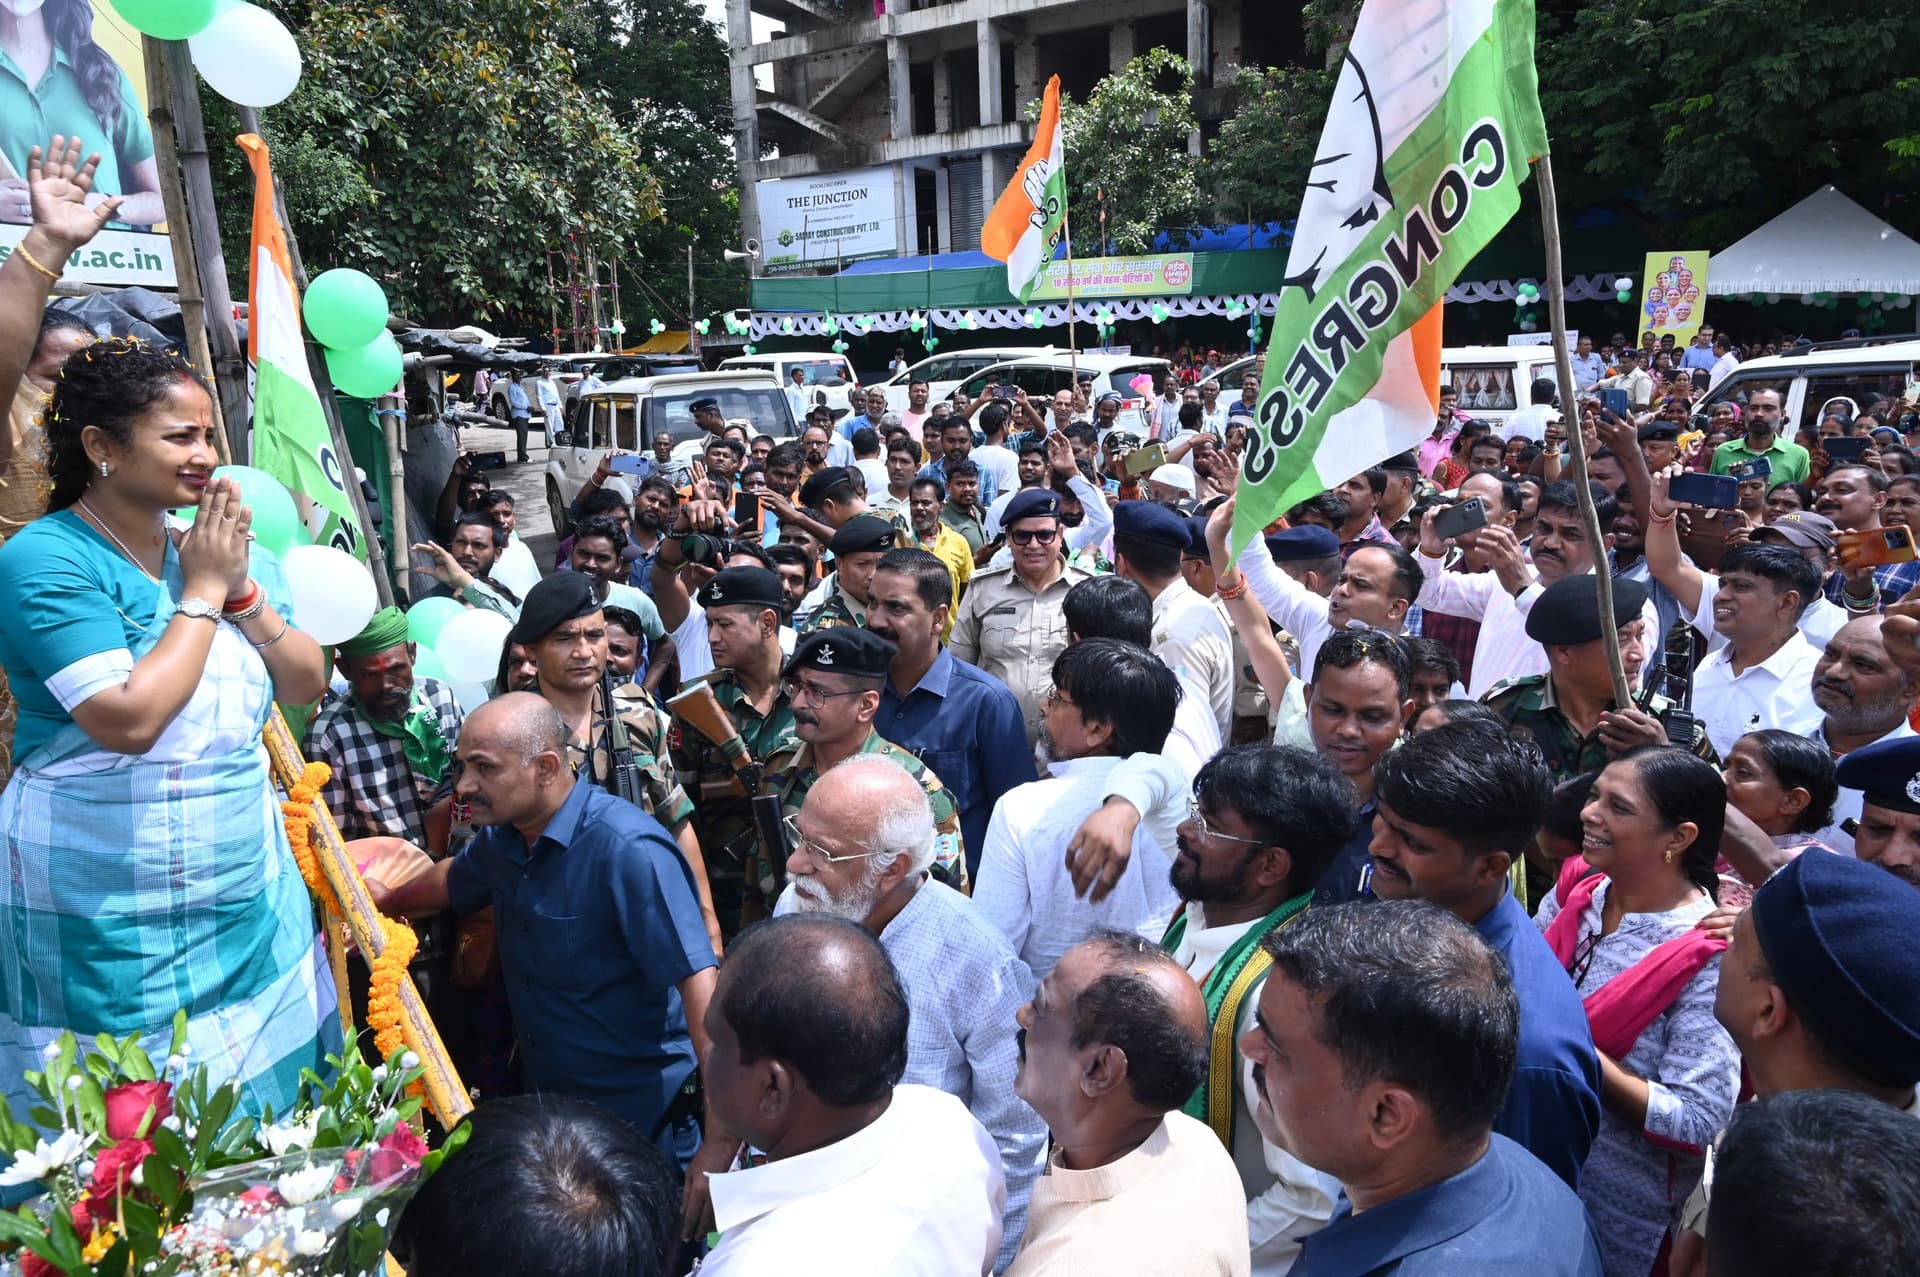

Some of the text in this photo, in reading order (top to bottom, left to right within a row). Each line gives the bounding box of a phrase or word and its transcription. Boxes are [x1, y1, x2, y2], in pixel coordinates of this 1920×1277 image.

[786, 188, 868, 209] THE JUNCTION
[816, 225, 855, 238] CONSTRUCTION
[869, 221, 881, 231] LTD.
